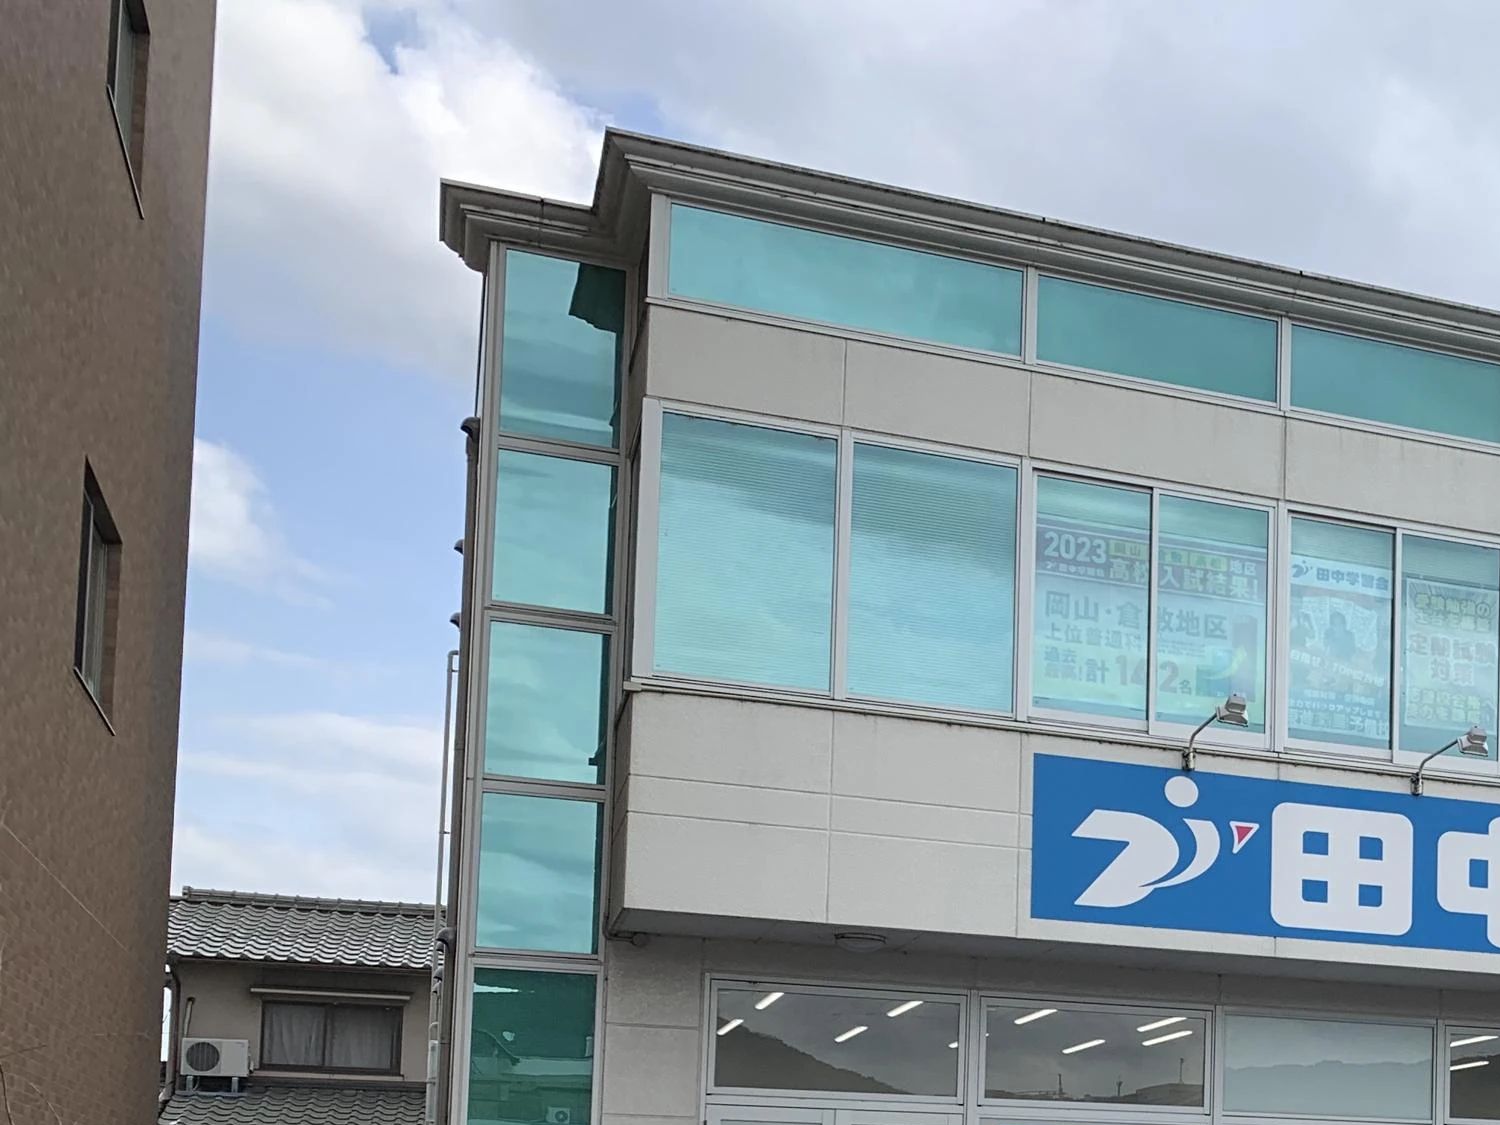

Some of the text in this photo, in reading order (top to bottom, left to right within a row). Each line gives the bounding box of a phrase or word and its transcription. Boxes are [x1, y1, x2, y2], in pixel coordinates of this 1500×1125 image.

[1044, 531, 1107, 564] 2023
[1316, 567, 1389, 592] 田中学習会
